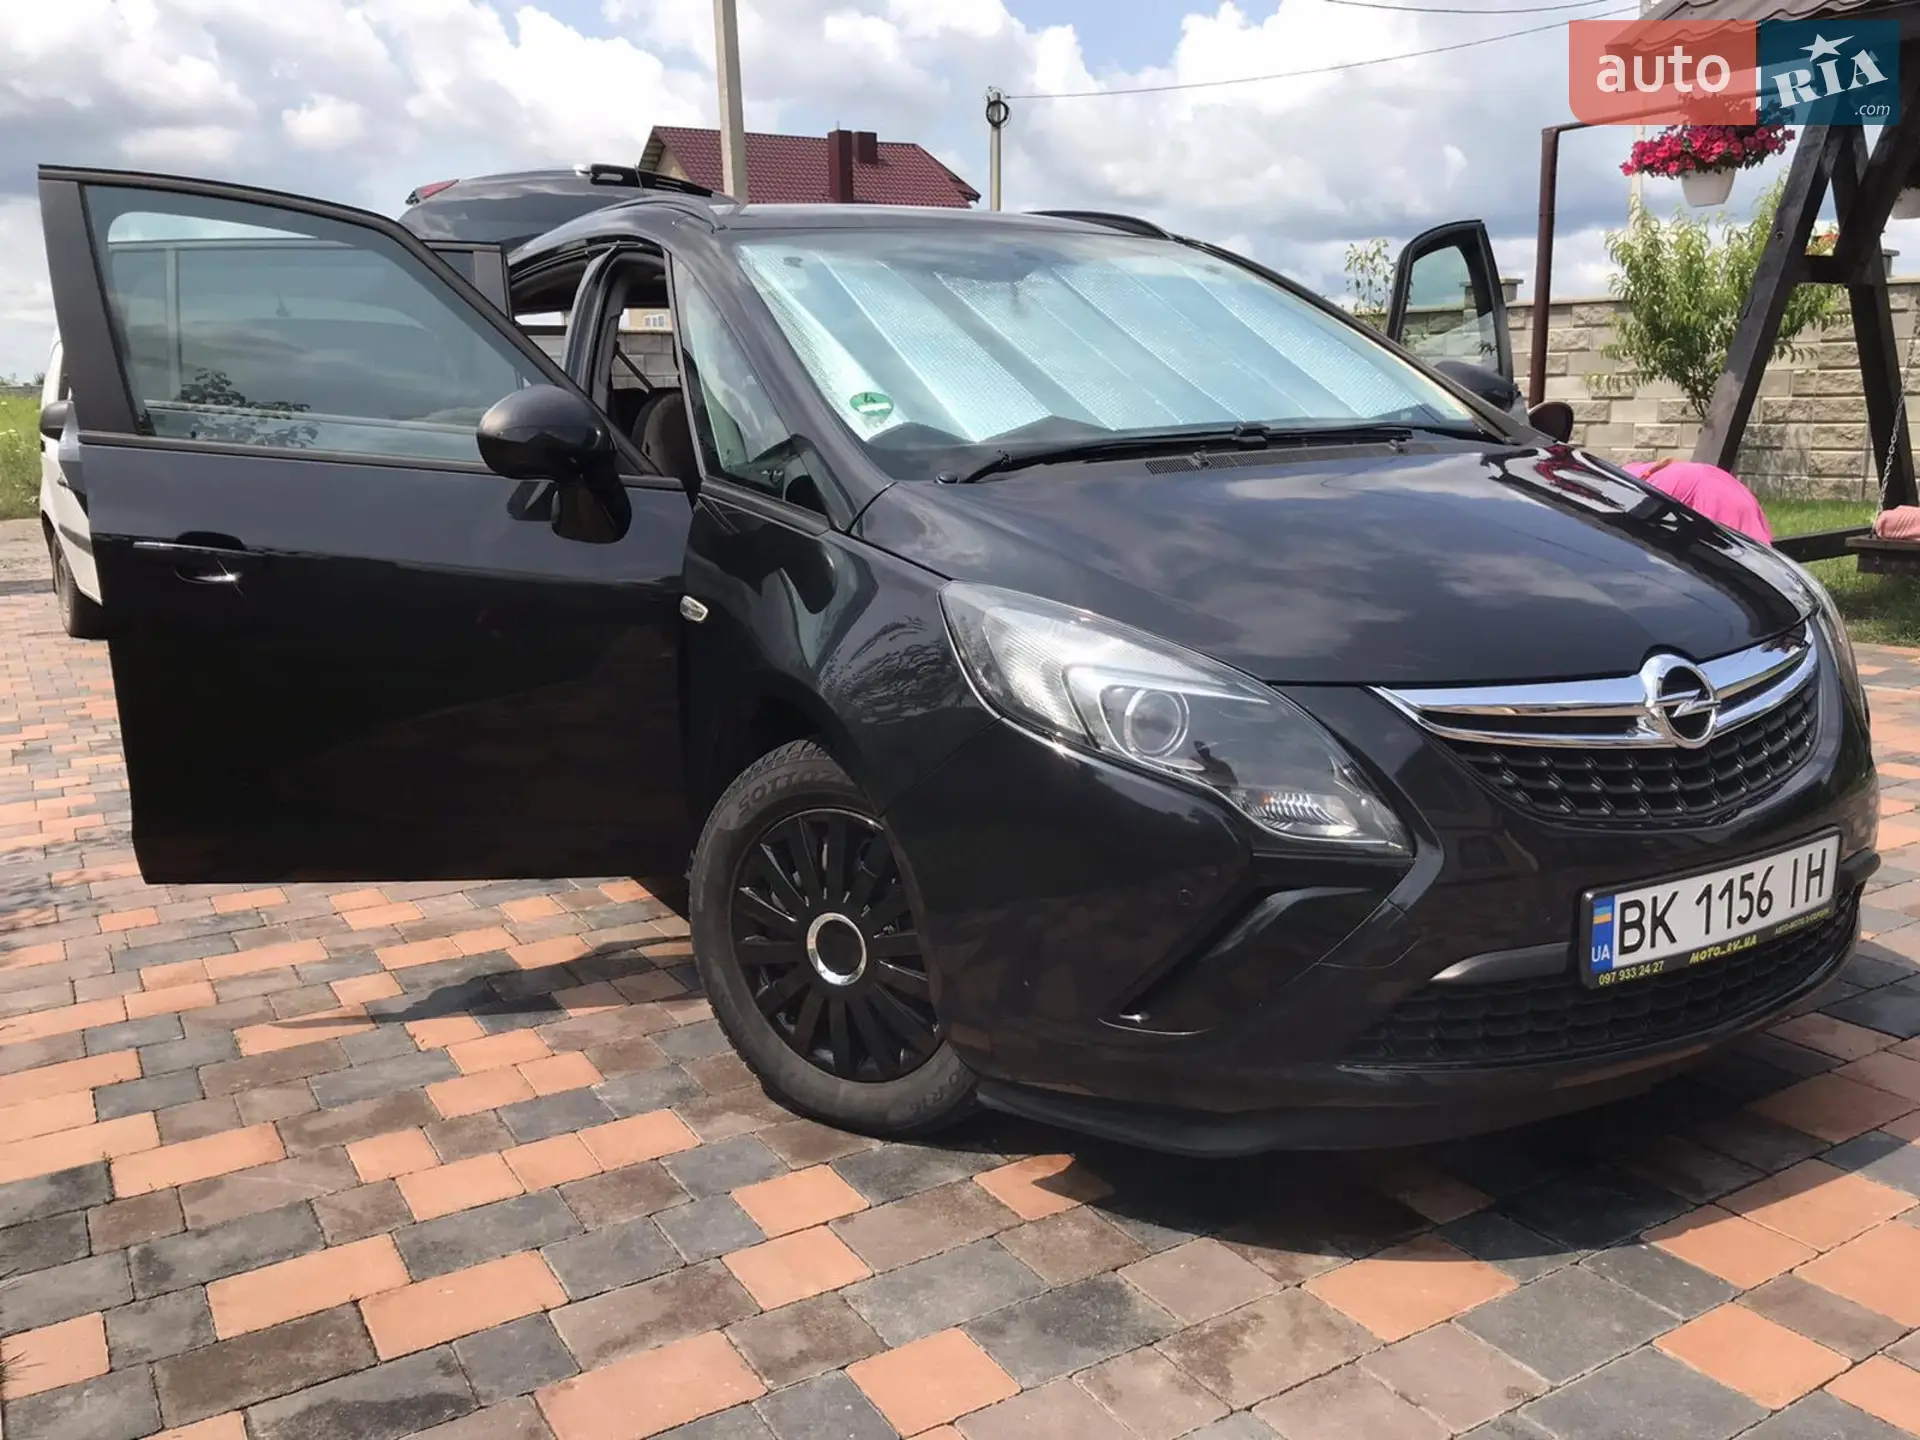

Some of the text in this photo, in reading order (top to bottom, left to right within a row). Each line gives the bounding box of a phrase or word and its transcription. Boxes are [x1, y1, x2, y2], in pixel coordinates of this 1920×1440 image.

[1618, 890, 1679, 956] BK
[1695, 864, 1774, 936] 1156
[1789, 848, 1827, 909] IH
[1591, 943, 1611, 963] UA
[1598, 960, 1665, 986] 097 933 24 27
